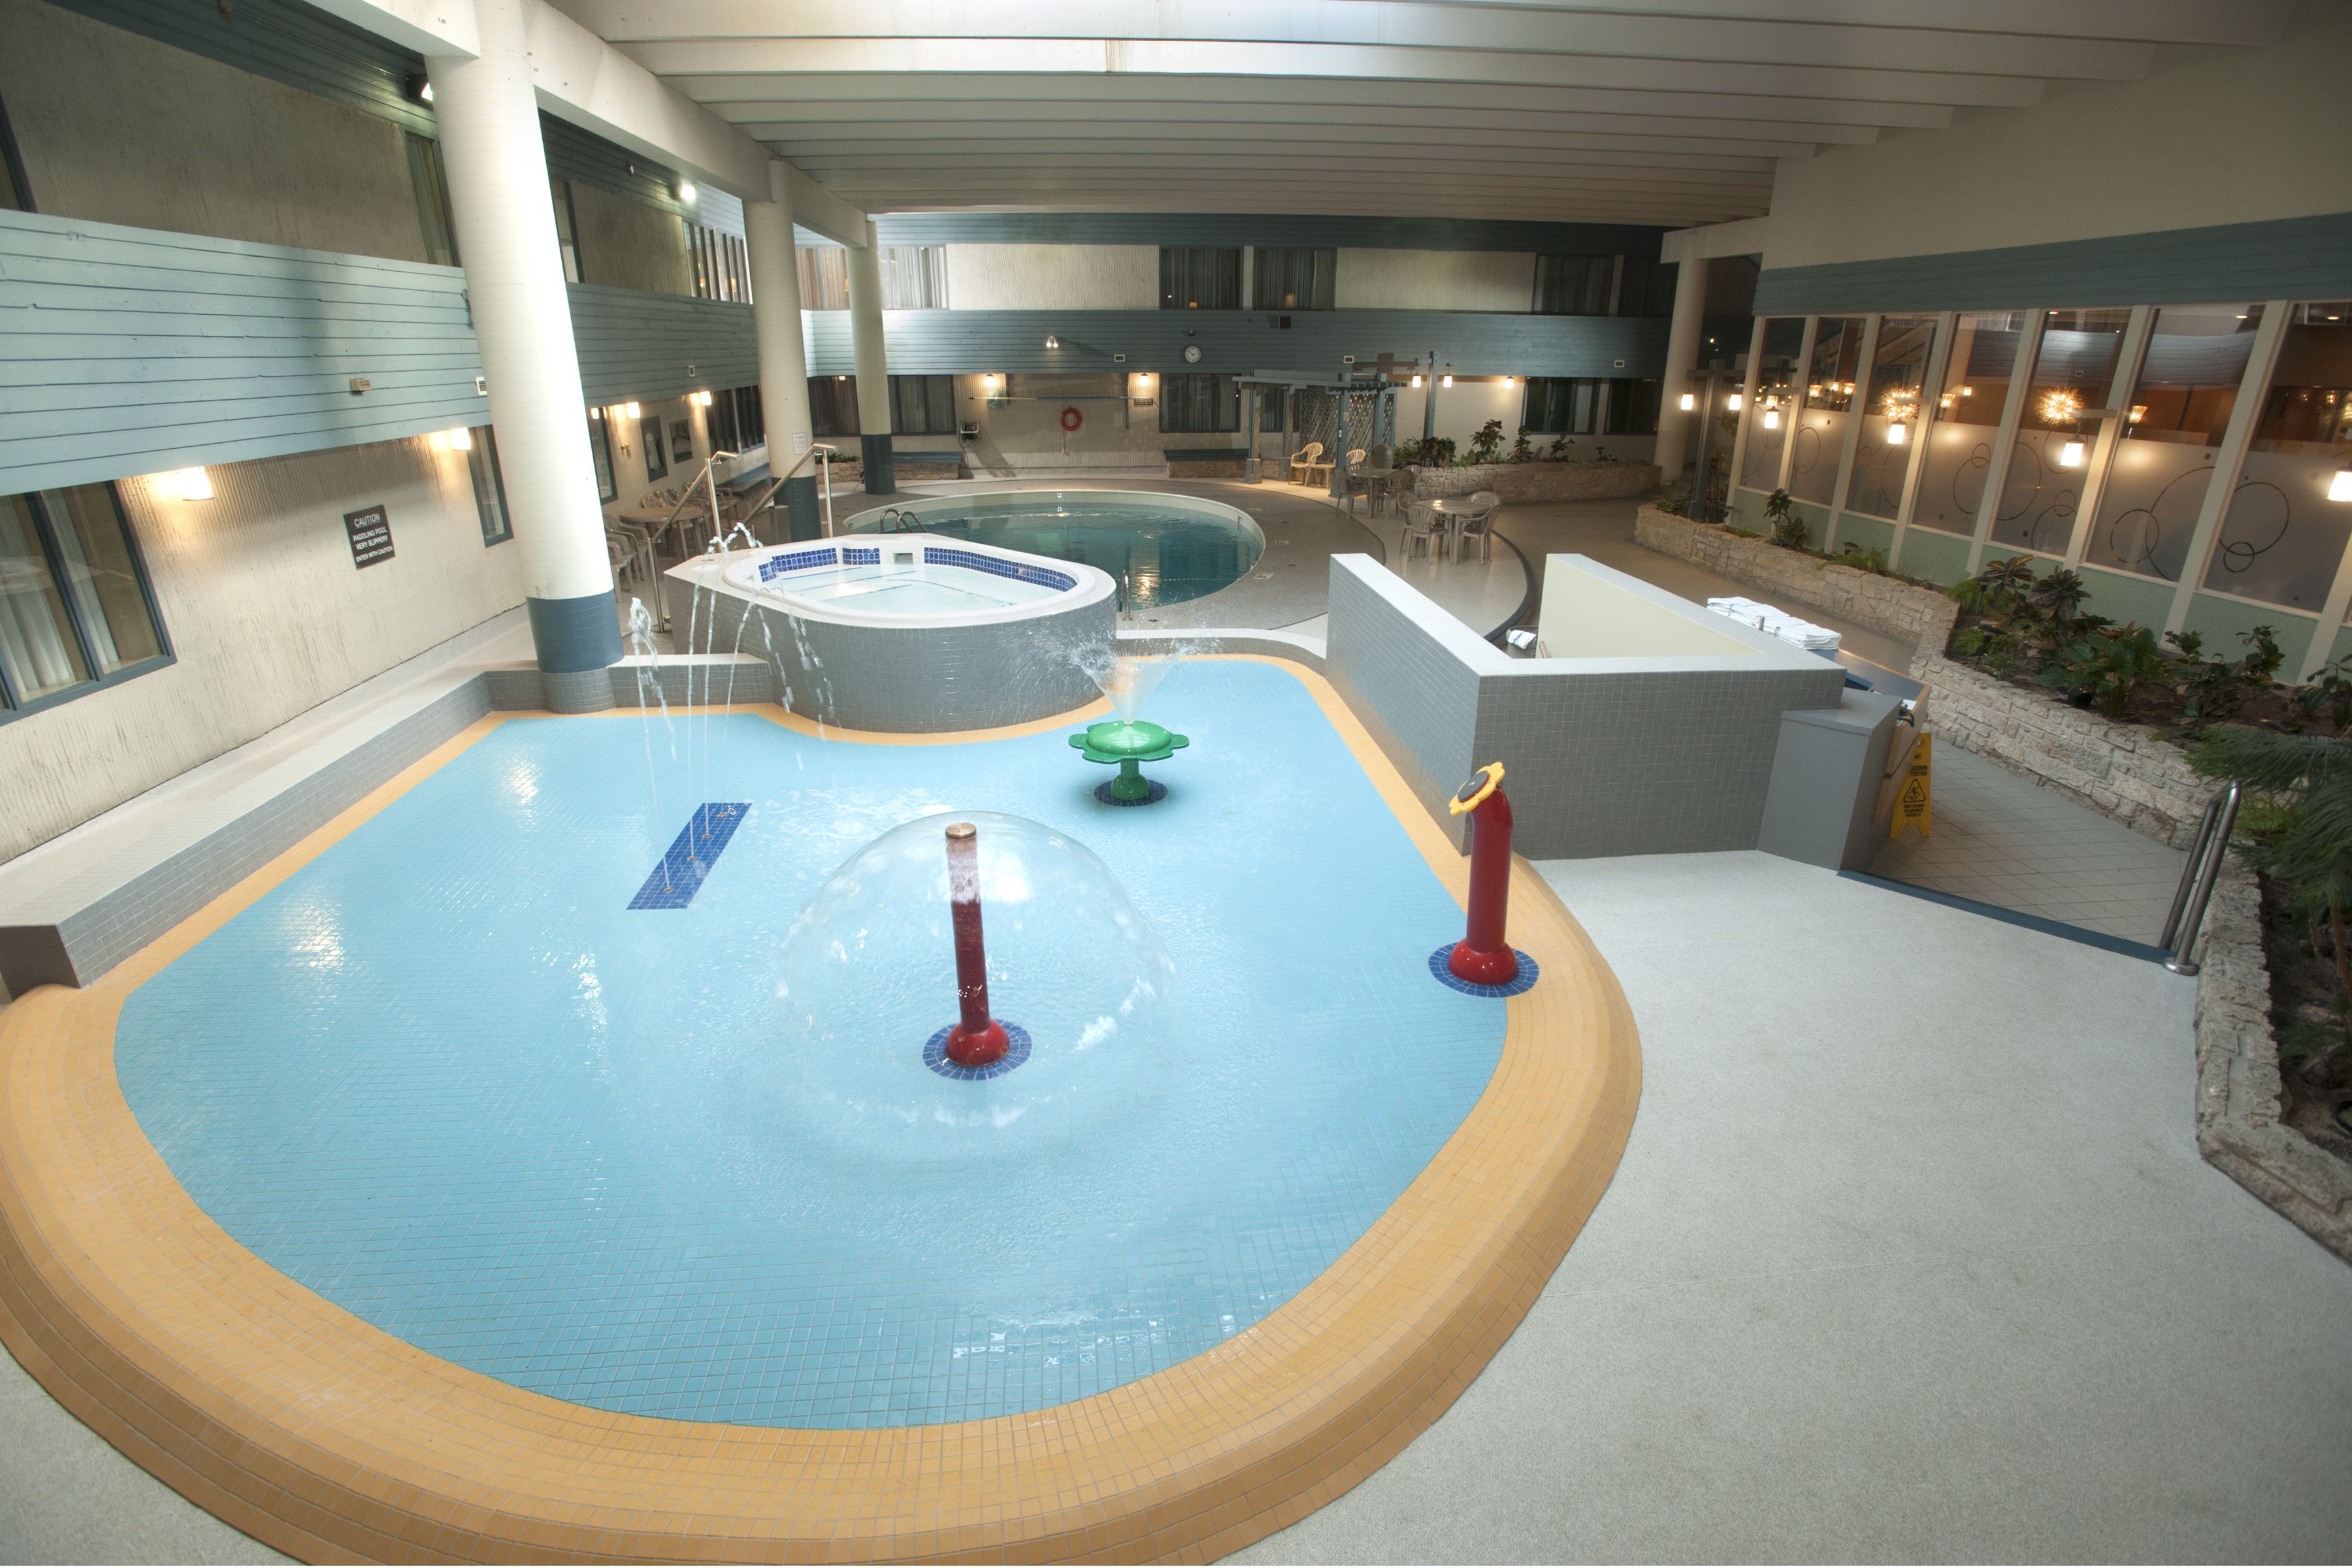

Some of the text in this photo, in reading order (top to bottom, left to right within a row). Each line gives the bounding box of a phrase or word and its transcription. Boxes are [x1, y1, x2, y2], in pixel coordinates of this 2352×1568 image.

[354, 513, 380, 527] CAUTION
[353, 527, 387, 542] PADDLING POOL
[355, 535, 388, 550] VERY SLIPPERY
[355, 554, 368, 563] ENTER
[378, 546, 393, 555] CAUTION
